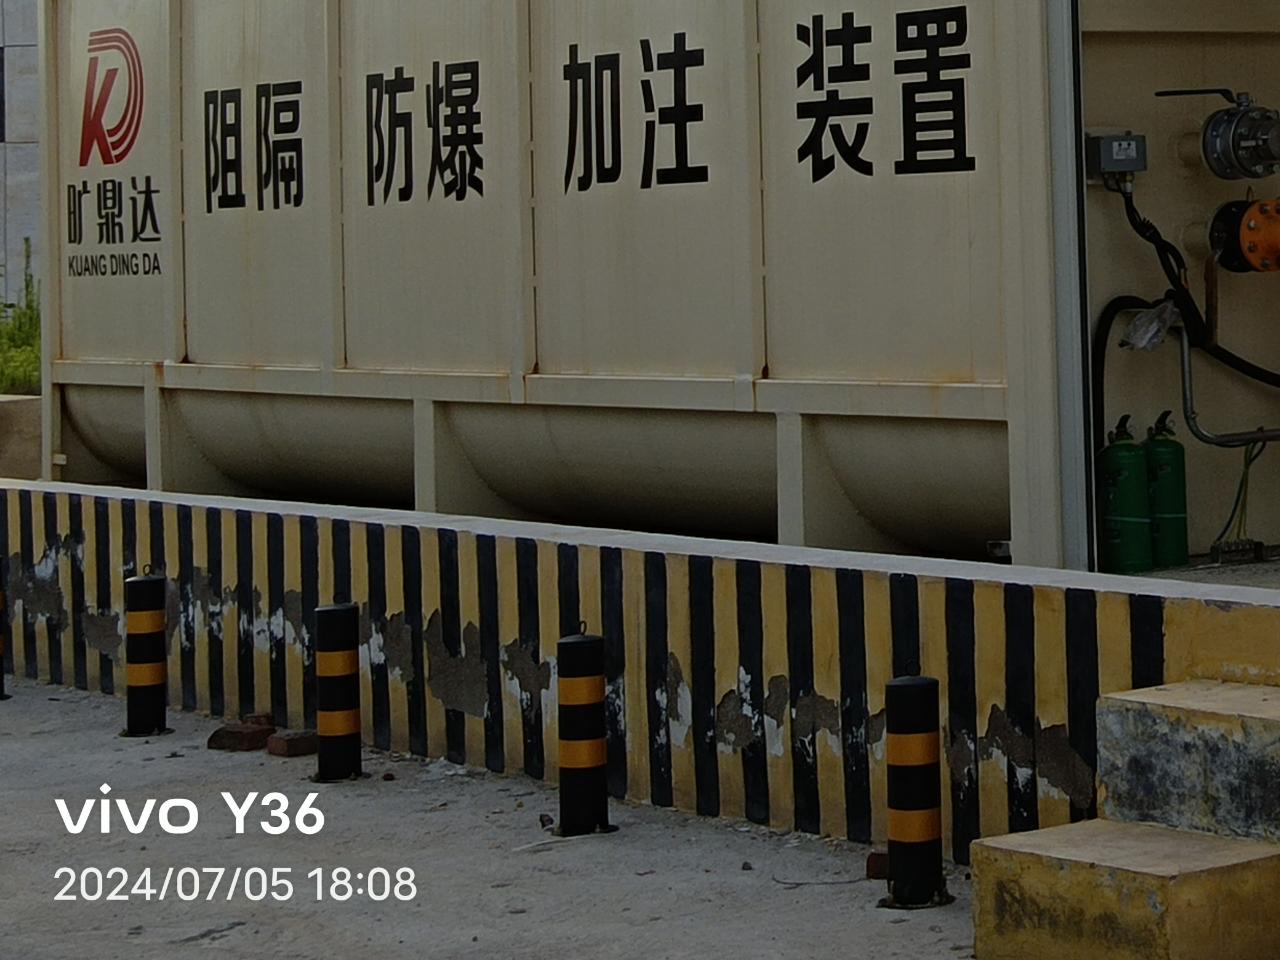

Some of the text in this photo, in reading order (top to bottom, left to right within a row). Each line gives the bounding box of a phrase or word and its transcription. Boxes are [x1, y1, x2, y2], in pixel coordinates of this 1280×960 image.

[204, 6, 976, 213] 阻隔 防爆 加注 装置
[68, 252, 161, 277] KUANG DING DA
